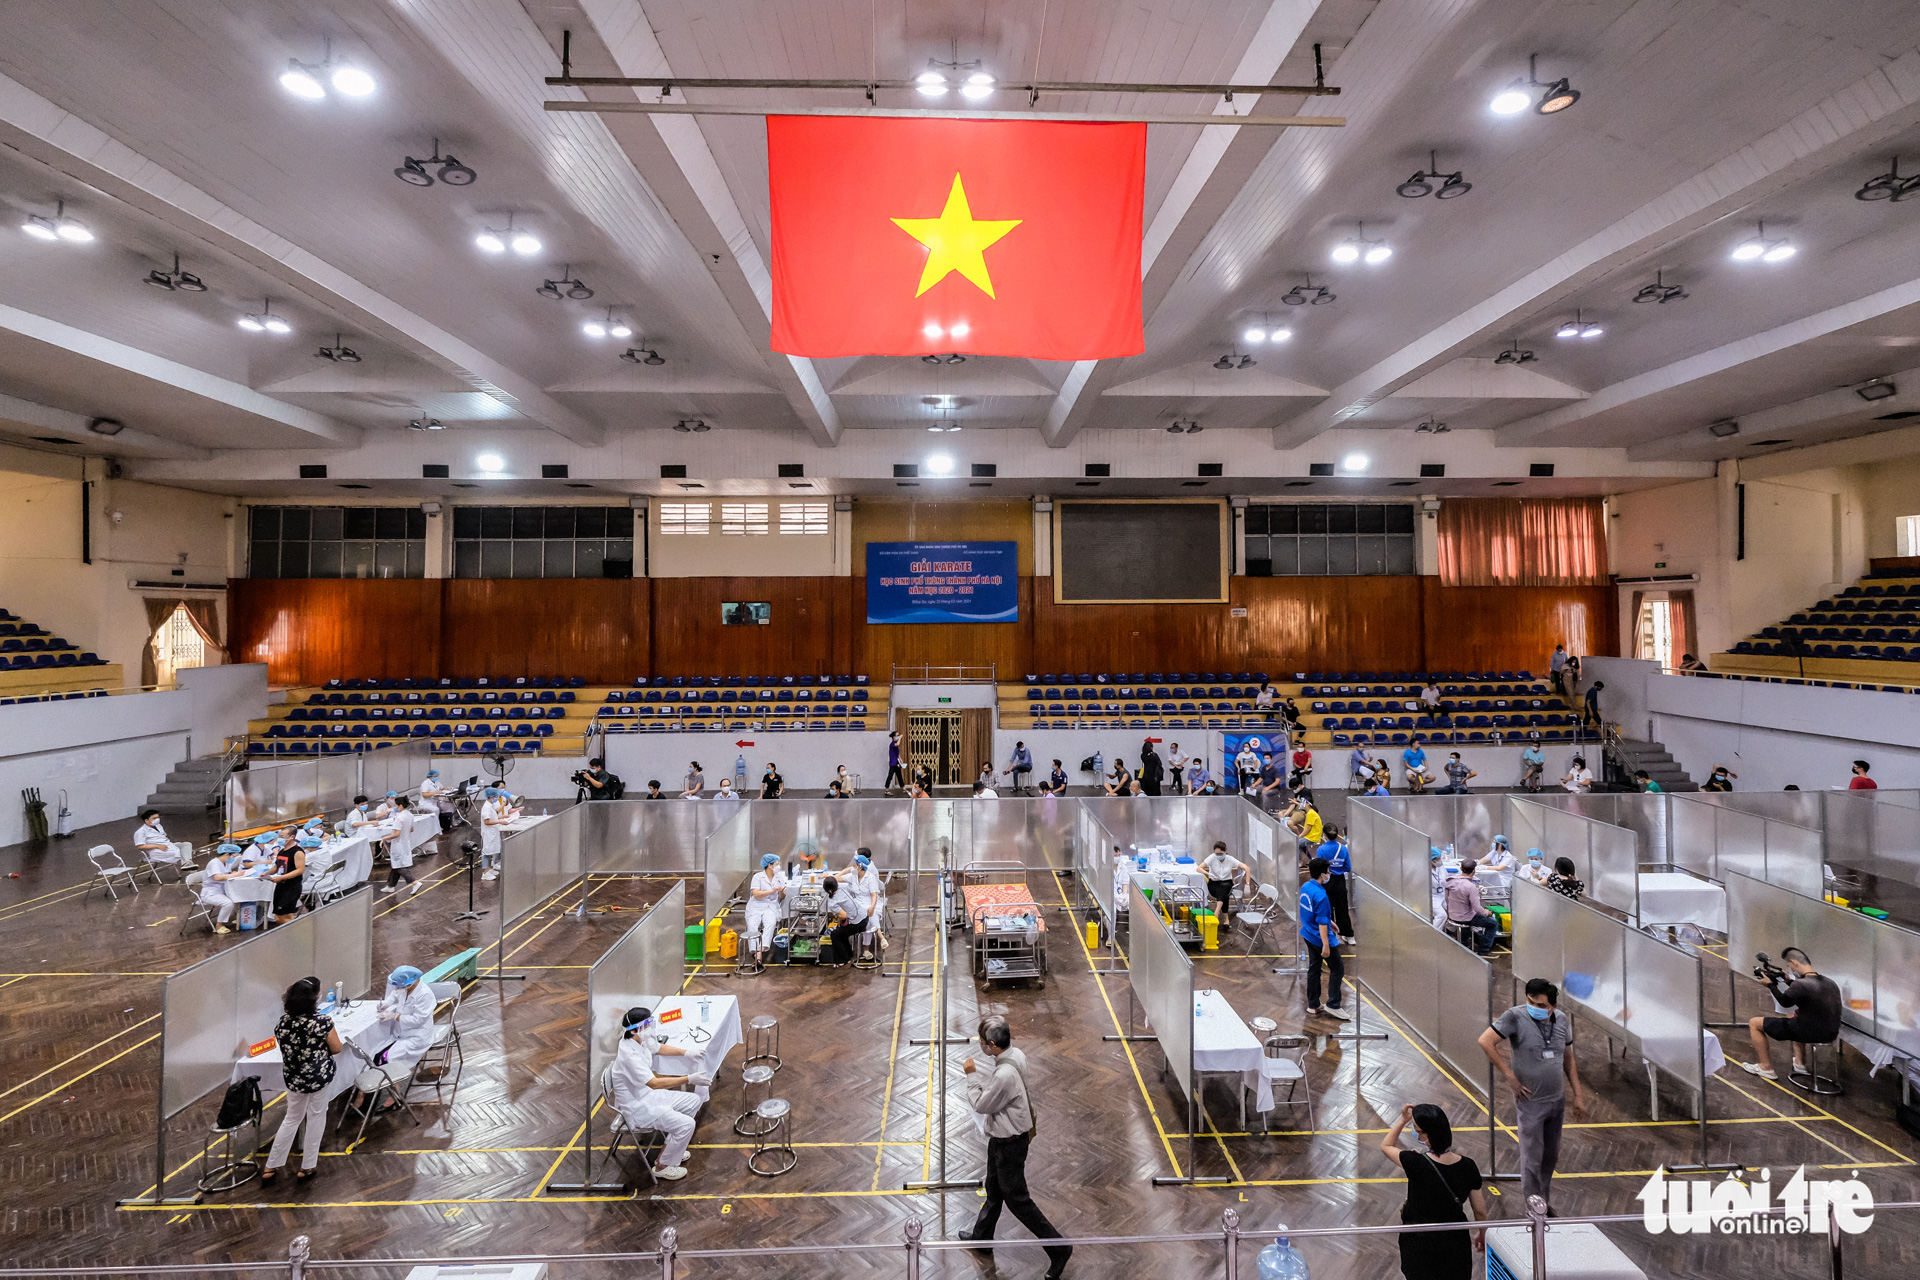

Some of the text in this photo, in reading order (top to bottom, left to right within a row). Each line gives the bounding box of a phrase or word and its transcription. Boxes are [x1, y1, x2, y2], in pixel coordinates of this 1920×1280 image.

[910, 558, 972, 573] GIẢI KARATE
[894, 577, 910, 585] SINH
[981, 575, 990, 585] HÀ
[991, 574, 1003, 586] NỘI
[938, 586, 954, 595] 2020
[959, 586, 974, 594] 2021
[1252, 739, 1258, 747] 2
